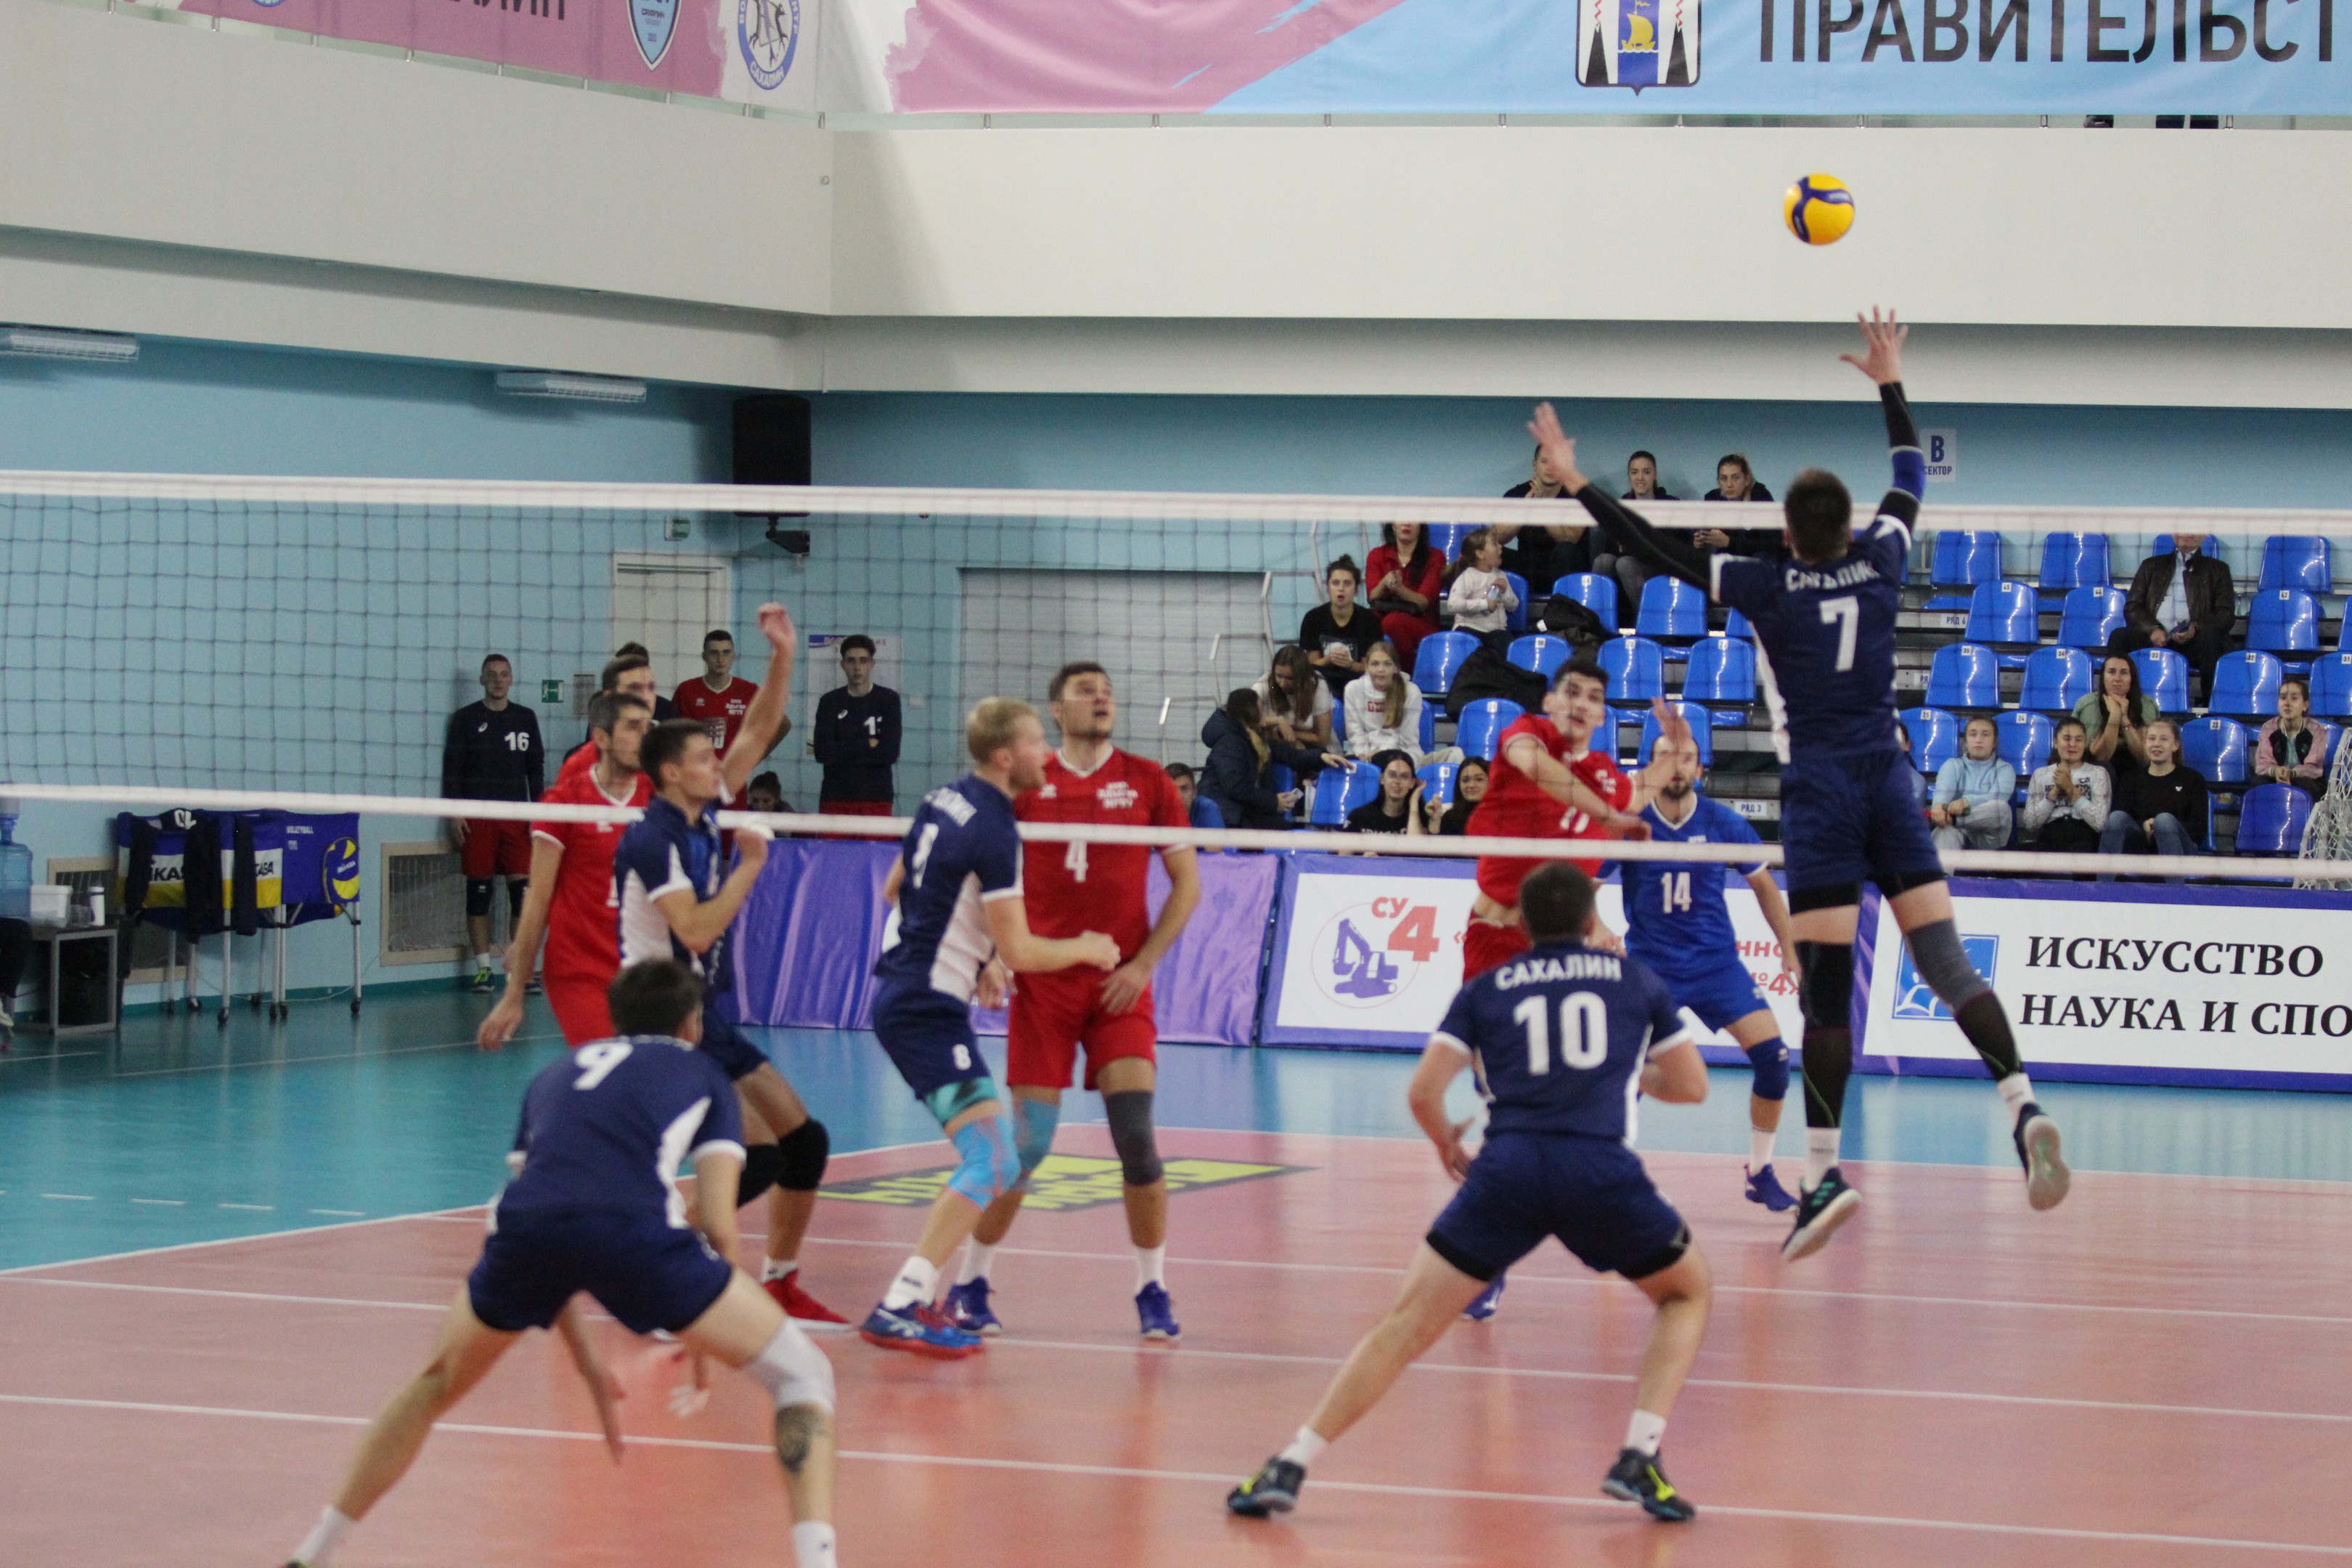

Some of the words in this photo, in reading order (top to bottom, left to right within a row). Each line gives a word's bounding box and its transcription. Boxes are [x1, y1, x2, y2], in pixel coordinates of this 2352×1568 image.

[1931, 435, 1944, 462] В
[1819, 595, 1859, 672] 7
[505, 732, 529, 751] 16
[1741, 804, 1755, 812] РЯД
[256, 861, 274, 876] ASA
[1064, 840, 1089, 883] 4
[1371, 897, 1409, 918] СУ
[1661, 872, 1692, 914] 14
[1387, 906, 1440, 962] 4
[1495, 954, 1622, 991] САХАЛИН
[2025, 936, 2324, 978] ИСКУССТВО
[1514, 991, 1608, 1077] 10
[2019, 994, 2186, 1032] НАУКА
[2200, 1001, 2239, 1032] И
[2251, 1003, 2352, 1037] СПО
[573, 1042, 634, 1090] 9
[952, 1044, 971, 1070] 8
